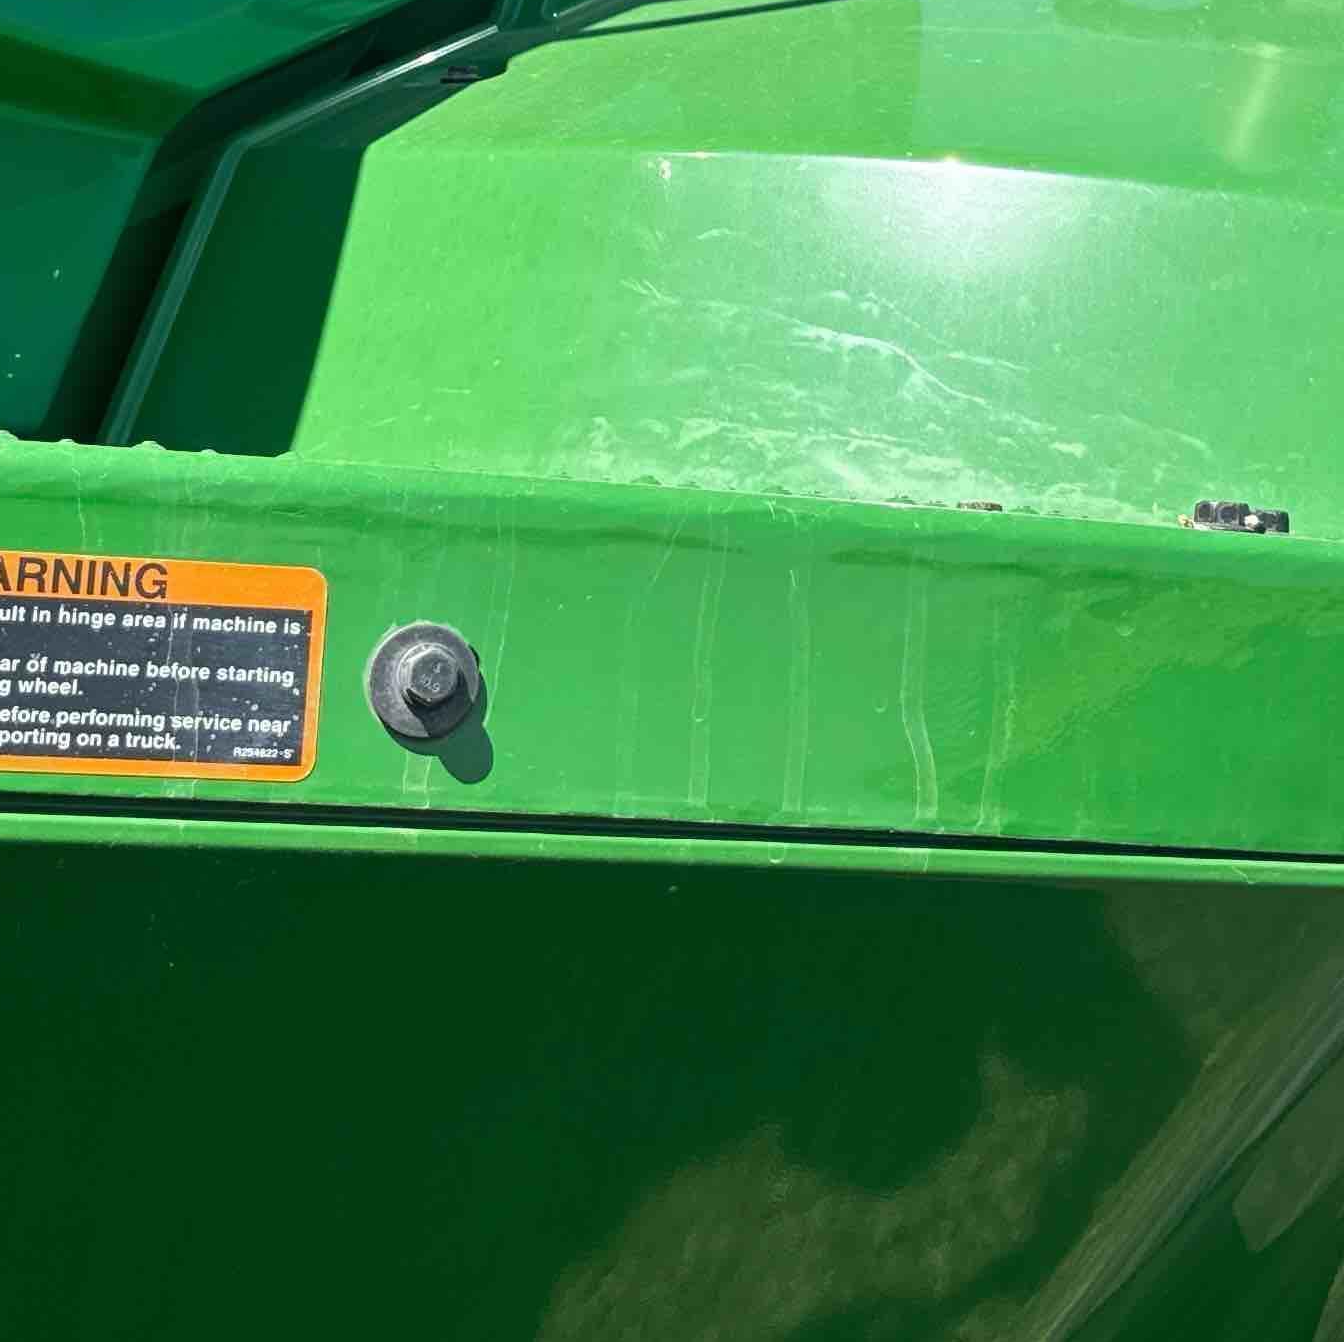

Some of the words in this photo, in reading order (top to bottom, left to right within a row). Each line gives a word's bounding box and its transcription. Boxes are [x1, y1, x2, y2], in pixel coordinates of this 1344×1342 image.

[32, 606, 51, 623] in
[58, 605, 116, 629] hinge
[122, 612, 166, 628] area
[173, 613, 187, 629] if
[193, 616, 277, 633] machine
[284, 618, 301, 634] is
[26, 657, 48, 673] of
[54, 658, 140, 677] machine
[147, 661, 210, 679] before
[217, 665, 295, 688] starting
[17, 678, 83, 695] wheel.
[55, 708, 164, 731] performing
[171, 714, 242, 731] service
[248, 719, 290, 733] near
[77, 732, 102, 748] on
[108, 735, 119, 748] a
[126, 732, 180, 750] truck.
